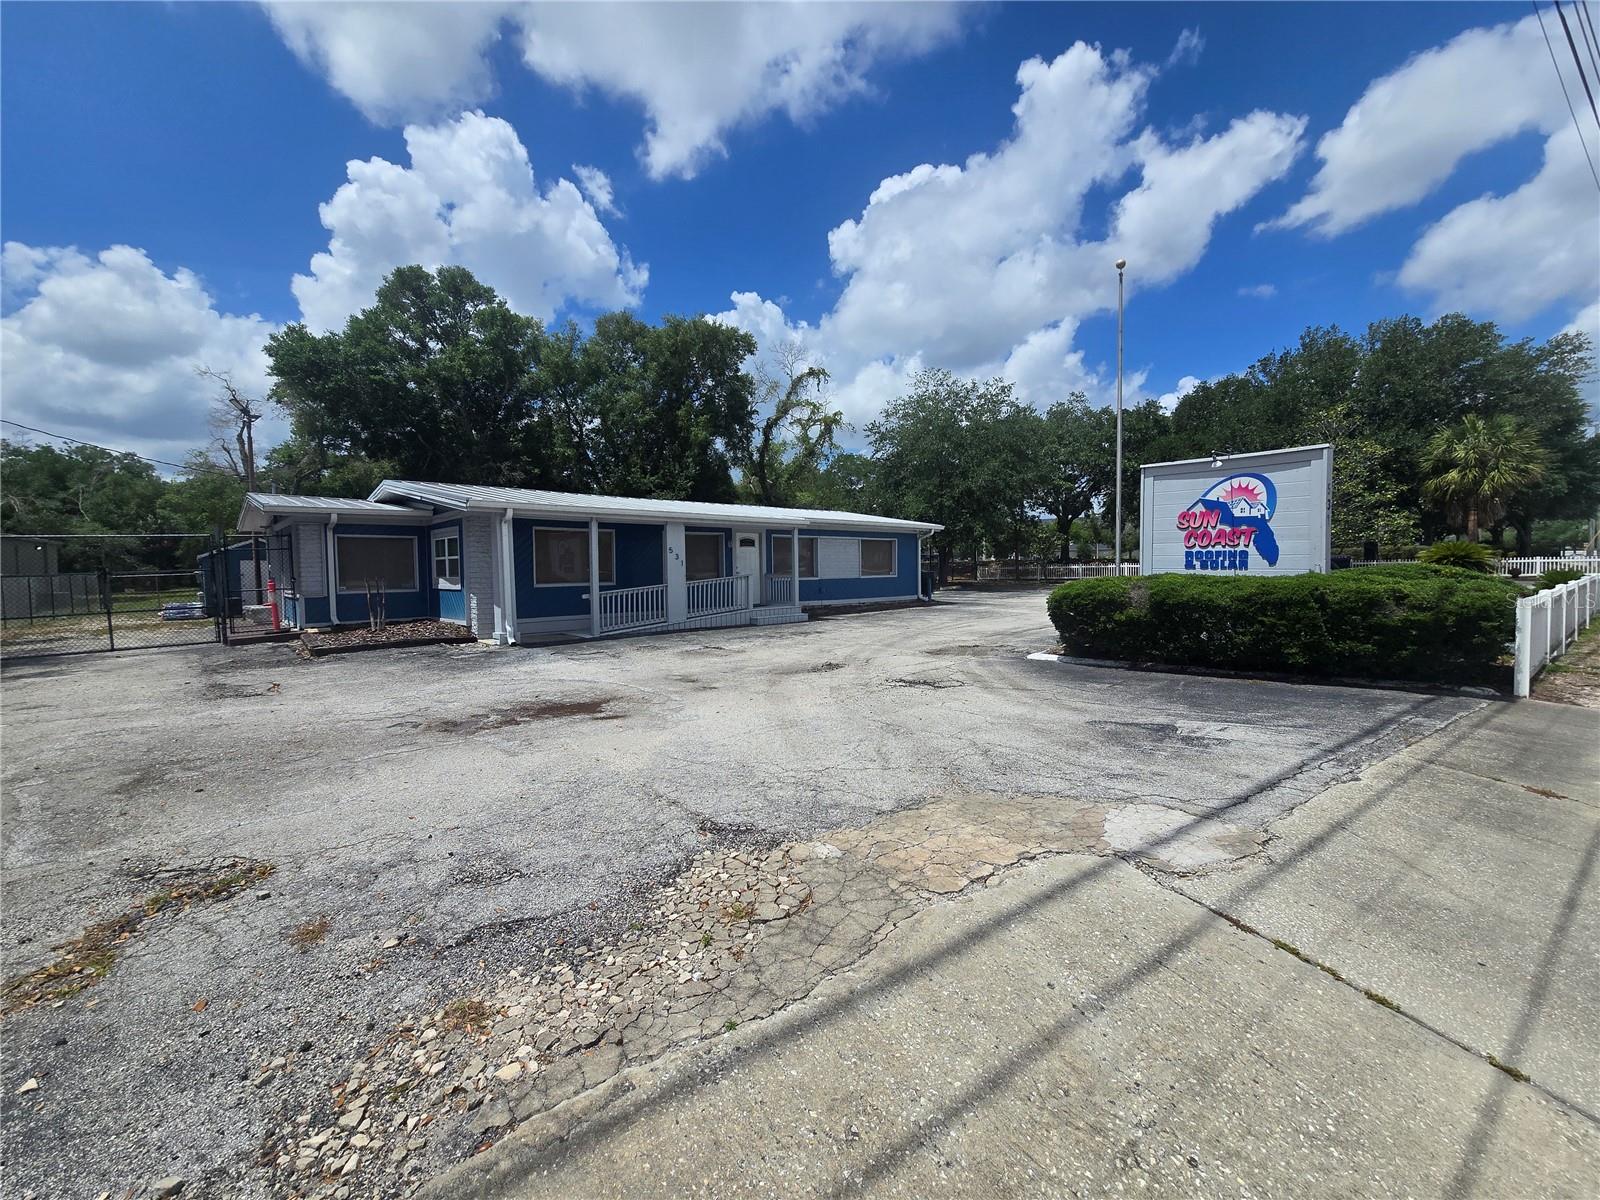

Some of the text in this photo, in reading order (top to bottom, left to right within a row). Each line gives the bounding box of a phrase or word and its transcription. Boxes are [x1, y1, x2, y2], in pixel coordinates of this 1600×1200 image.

[1177, 509, 1221, 531] SUN
[1183, 527, 1257, 549] COAST
[668, 546, 684, 567] 531
[1184, 550, 1249, 561] ROOFING
